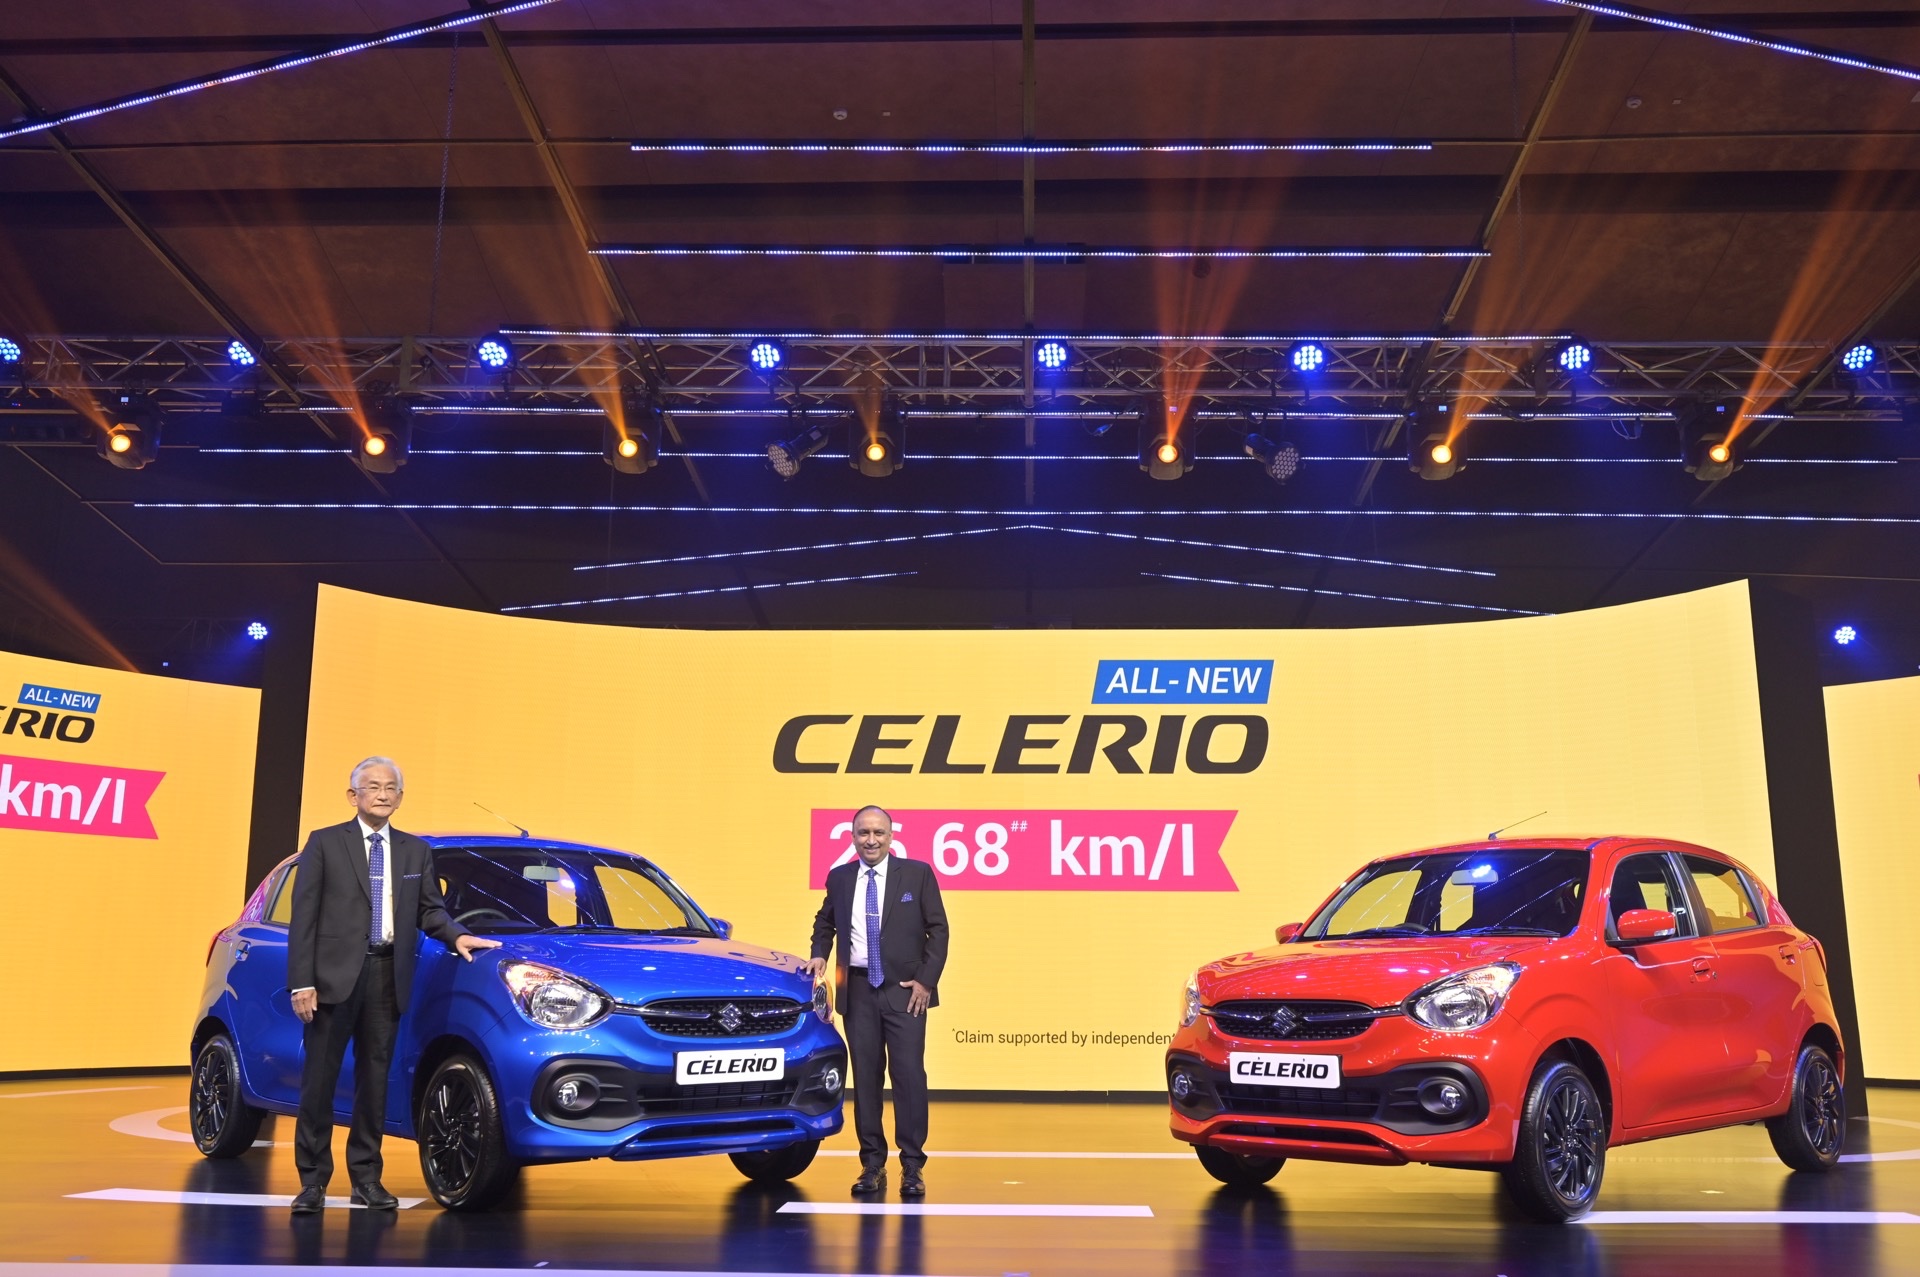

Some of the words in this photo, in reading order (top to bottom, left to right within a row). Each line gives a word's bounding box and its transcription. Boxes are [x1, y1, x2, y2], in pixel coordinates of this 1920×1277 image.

[0, 705, 95, 743] RIO
[772, 714, 1269, 775] CELERIO
[0, 763, 126, 825] km/l
[1050, 819, 1194, 881] km/l
[998, 1030, 1067, 1047] supported
[1071, 1030, 1088, 1048] by
[686, 1057, 777, 1076] CELERIO
[1236, 1060, 1329, 1080] CELERIO
